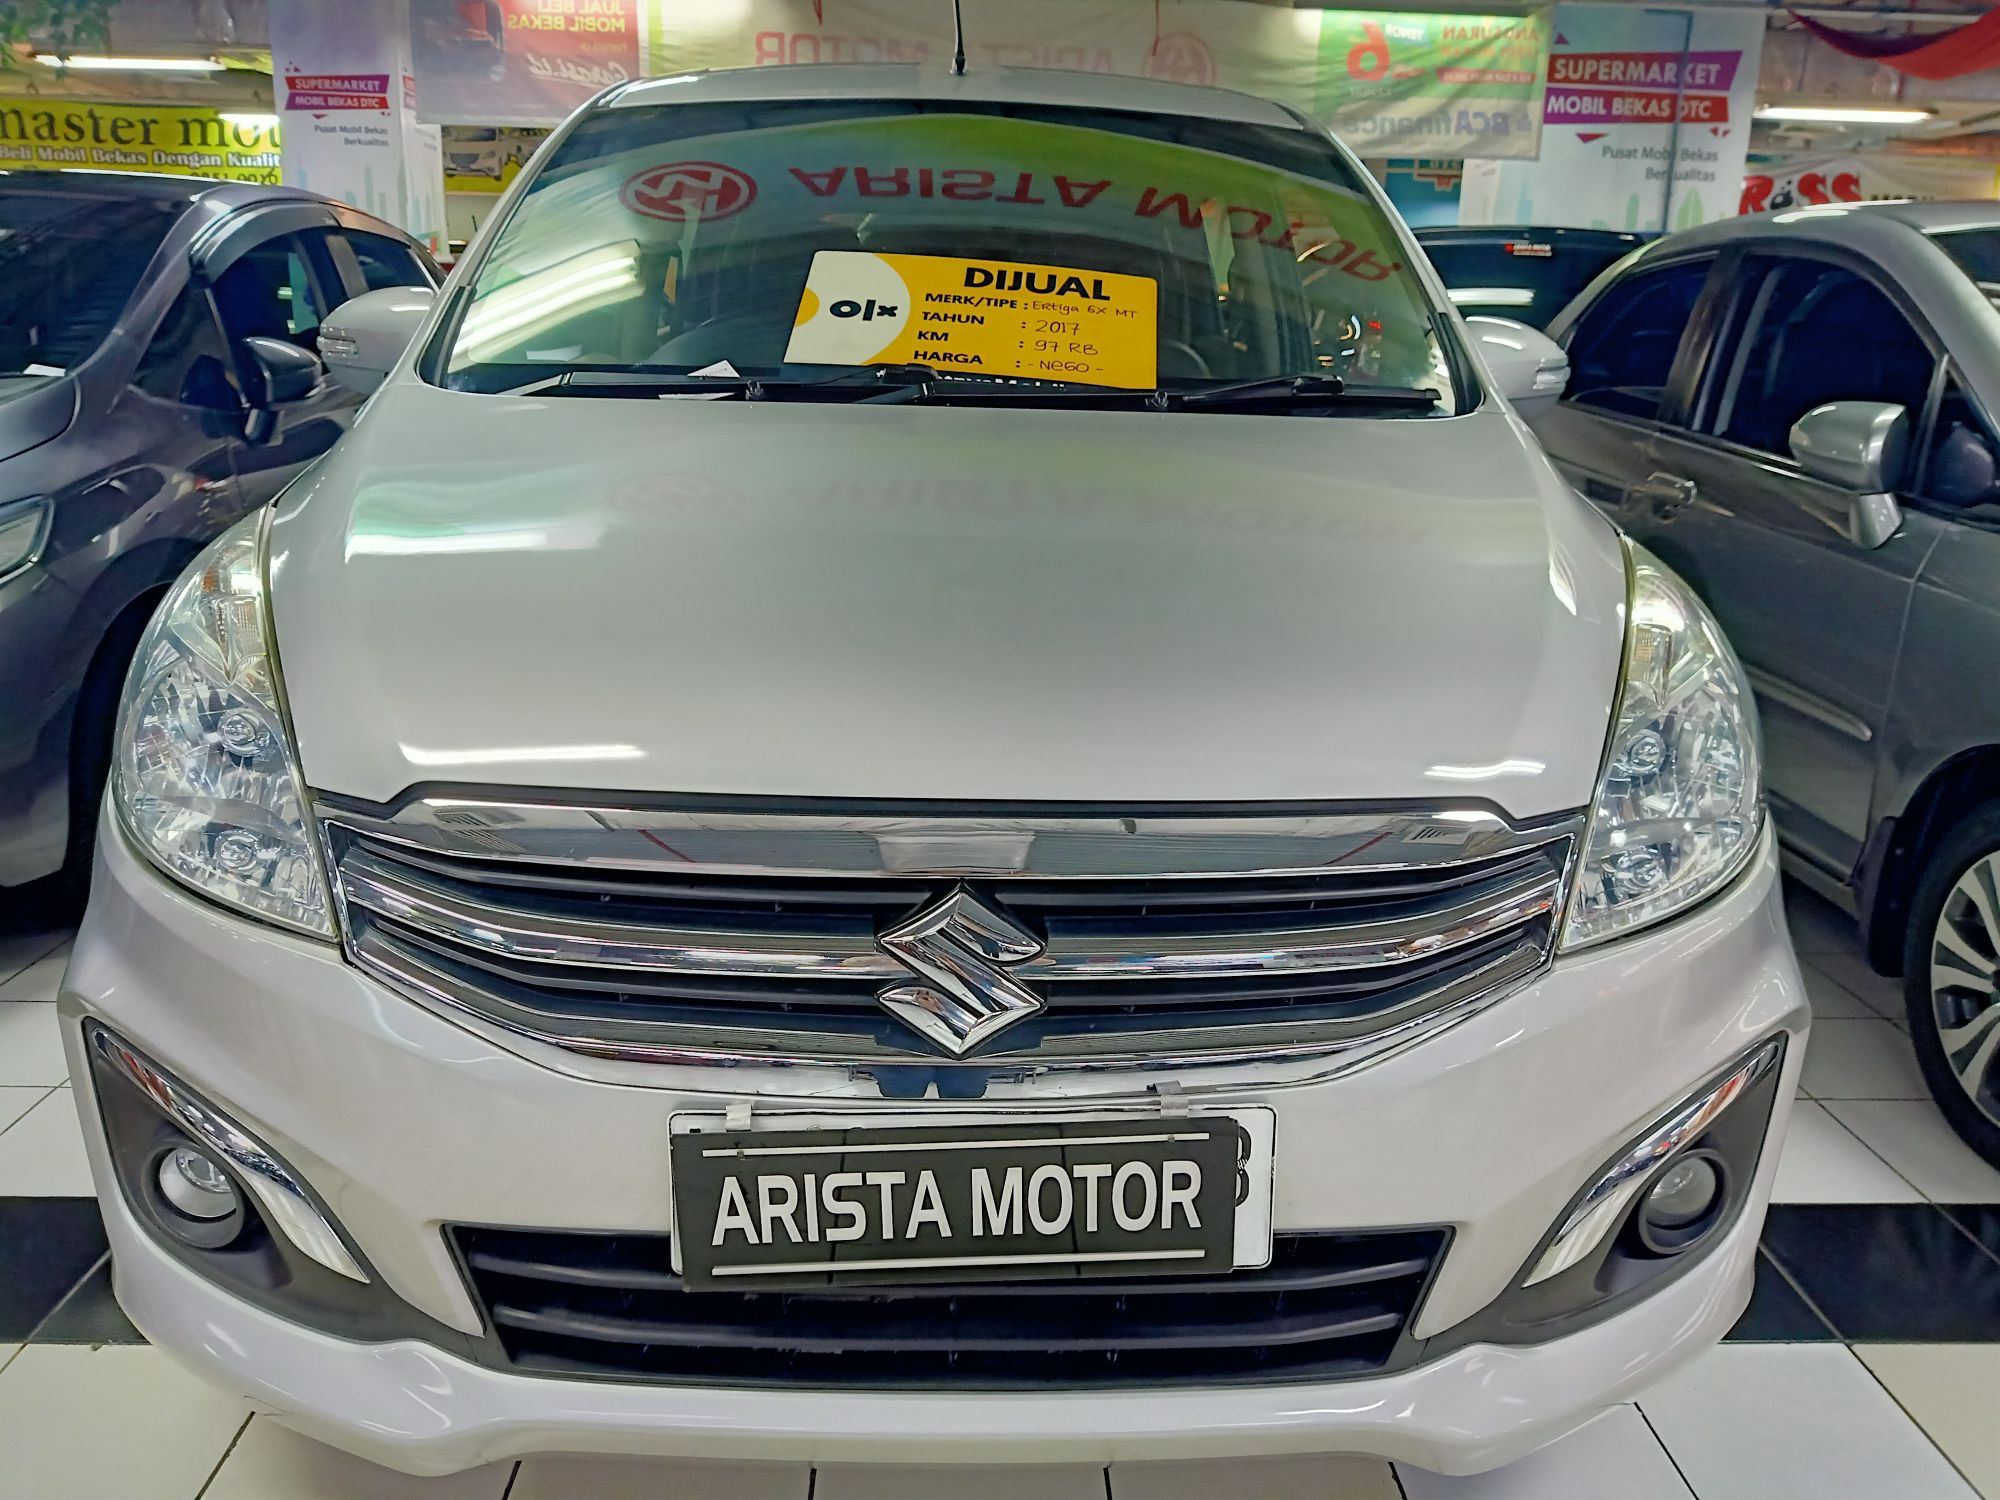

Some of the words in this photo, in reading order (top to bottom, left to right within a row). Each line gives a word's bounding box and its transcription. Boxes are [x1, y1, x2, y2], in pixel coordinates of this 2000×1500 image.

[295, 78, 380, 91] SUPERMARKET
[295, 95, 326, 106] MOBIL
[328, 96, 358, 107] BEKAS
[360, 97, 380, 108] DTC
[1547, 95, 1606, 115] MOBIL
[1612, 97, 1671, 117] BEKAS
[314, 124, 337, 134] Pusat
[339, 125, 362, 134] Mobil
[364, 125, 388, 135] Bekas
[38, 146, 87, 163] Mobil
[92, 148, 147, 165] Bekas
[154, 150, 221, 168] Dengan
[1602, 145, 1637, 160] Pusat
[1680, 147, 1718, 161] Bekas
[964, 266, 1110, 301] DIJUAL
[829, 299, 898, 321] olx
[925, 293, 1018, 309] MERK/TIPE
[1115, 309, 1138, 319] MT
[922, 311, 985, 325] TAHUN
[1035, 320, 1080, 336] 2017
[917, 330, 949, 342] KM
[1034, 340, 1059, 353] 97
[1069, 343, 1099, 356] RB
[913, 350, 983, 365] HARGA
[712, 1171, 953, 1247] ARISTA
[971, 1160, 1202, 1238] MOTOR
